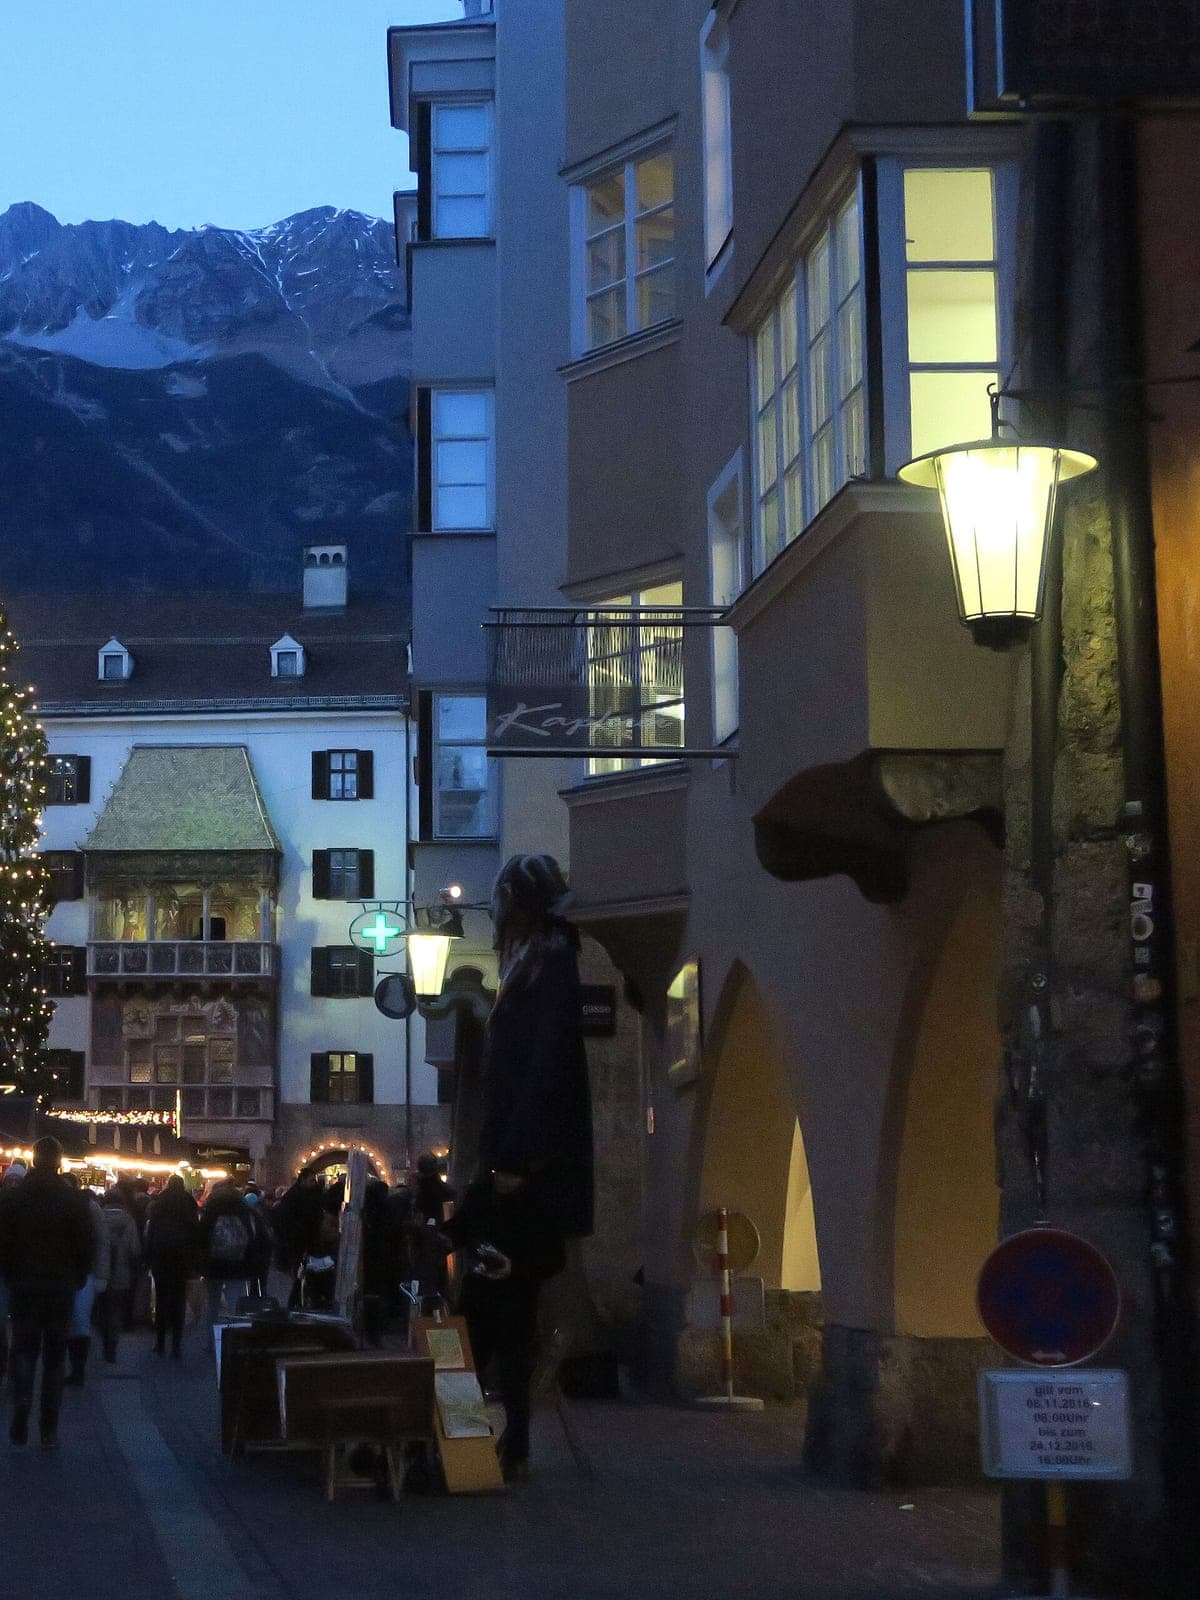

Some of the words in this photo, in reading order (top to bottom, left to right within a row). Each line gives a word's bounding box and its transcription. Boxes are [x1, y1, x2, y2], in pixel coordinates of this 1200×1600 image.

[1057, 1386, 1084, 1395] vom
[1038, 1427, 1057, 1437] bis
[1060, 1428, 1087, 1437] zum
